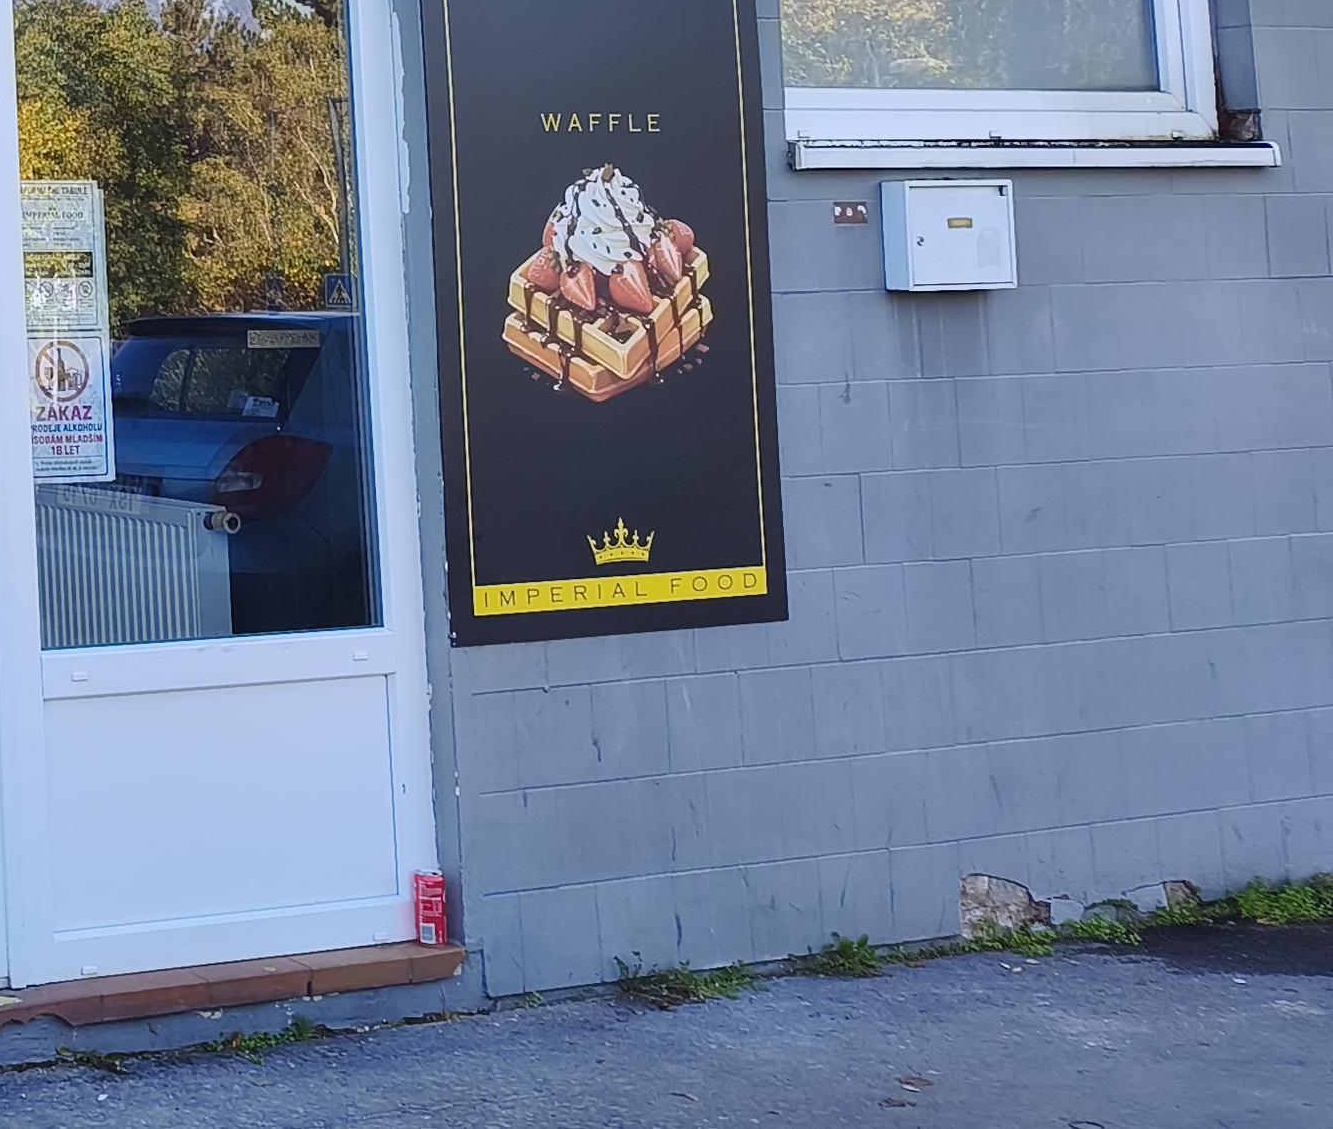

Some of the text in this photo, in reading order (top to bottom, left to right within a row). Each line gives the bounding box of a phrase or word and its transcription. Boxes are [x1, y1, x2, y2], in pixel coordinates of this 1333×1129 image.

[540, 112, 661, 133] WAFFLE
[63, 422, 102, 432] ALKOHOLU
[32, 434, 63, 444] SOBÁM
[51, 445, 81, 455] 18 LET
[483, 572, 757, 609] IMPERIAL FOOD
